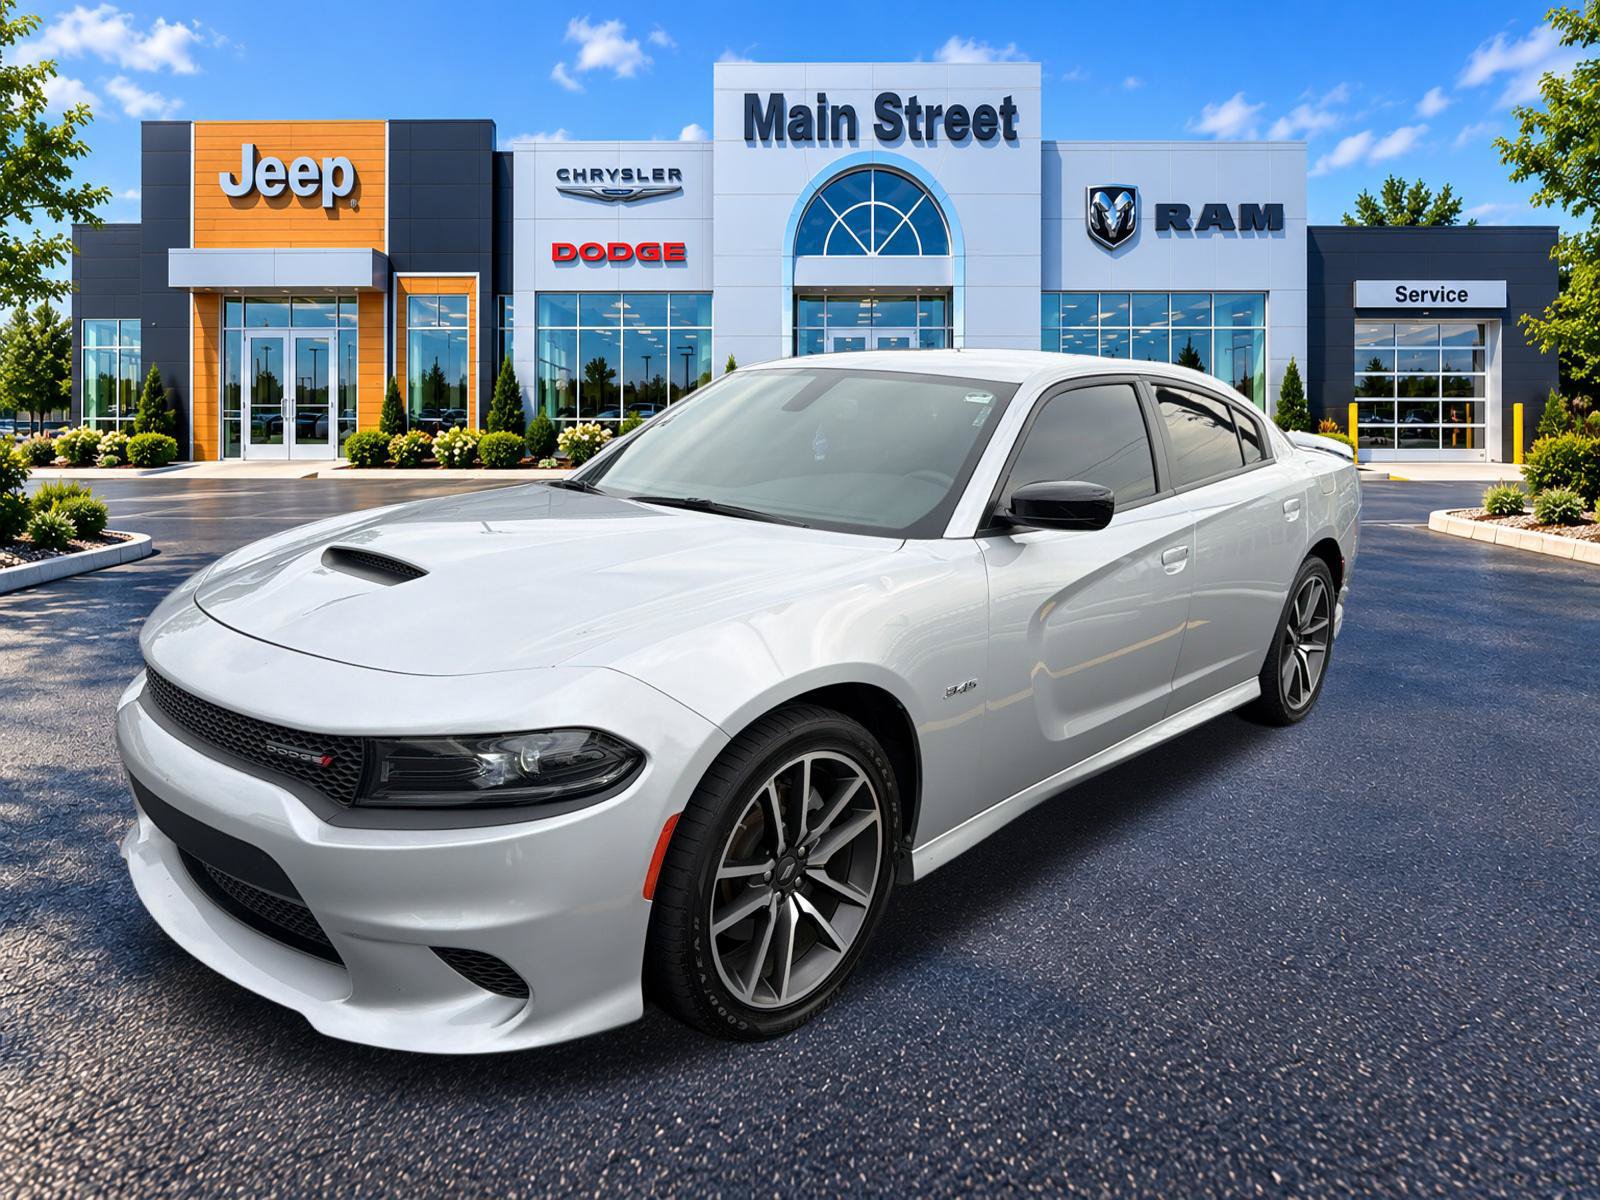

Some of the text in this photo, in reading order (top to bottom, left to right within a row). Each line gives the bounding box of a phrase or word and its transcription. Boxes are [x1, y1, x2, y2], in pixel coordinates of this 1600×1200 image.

[744, 91, 1017, 141] Main Street
[219, 143, 355, 208] Jeep
[556, 168, 682, 182] CHRYSLER
[1155, 203, 1284, 231] RAM
[551, 242, 687, 262] DODGE
[1395, 285, 1469, 303] Service
[266, 744, 323, 765] DODGE
[693, 916, 749, 1031] GOODYEAR
